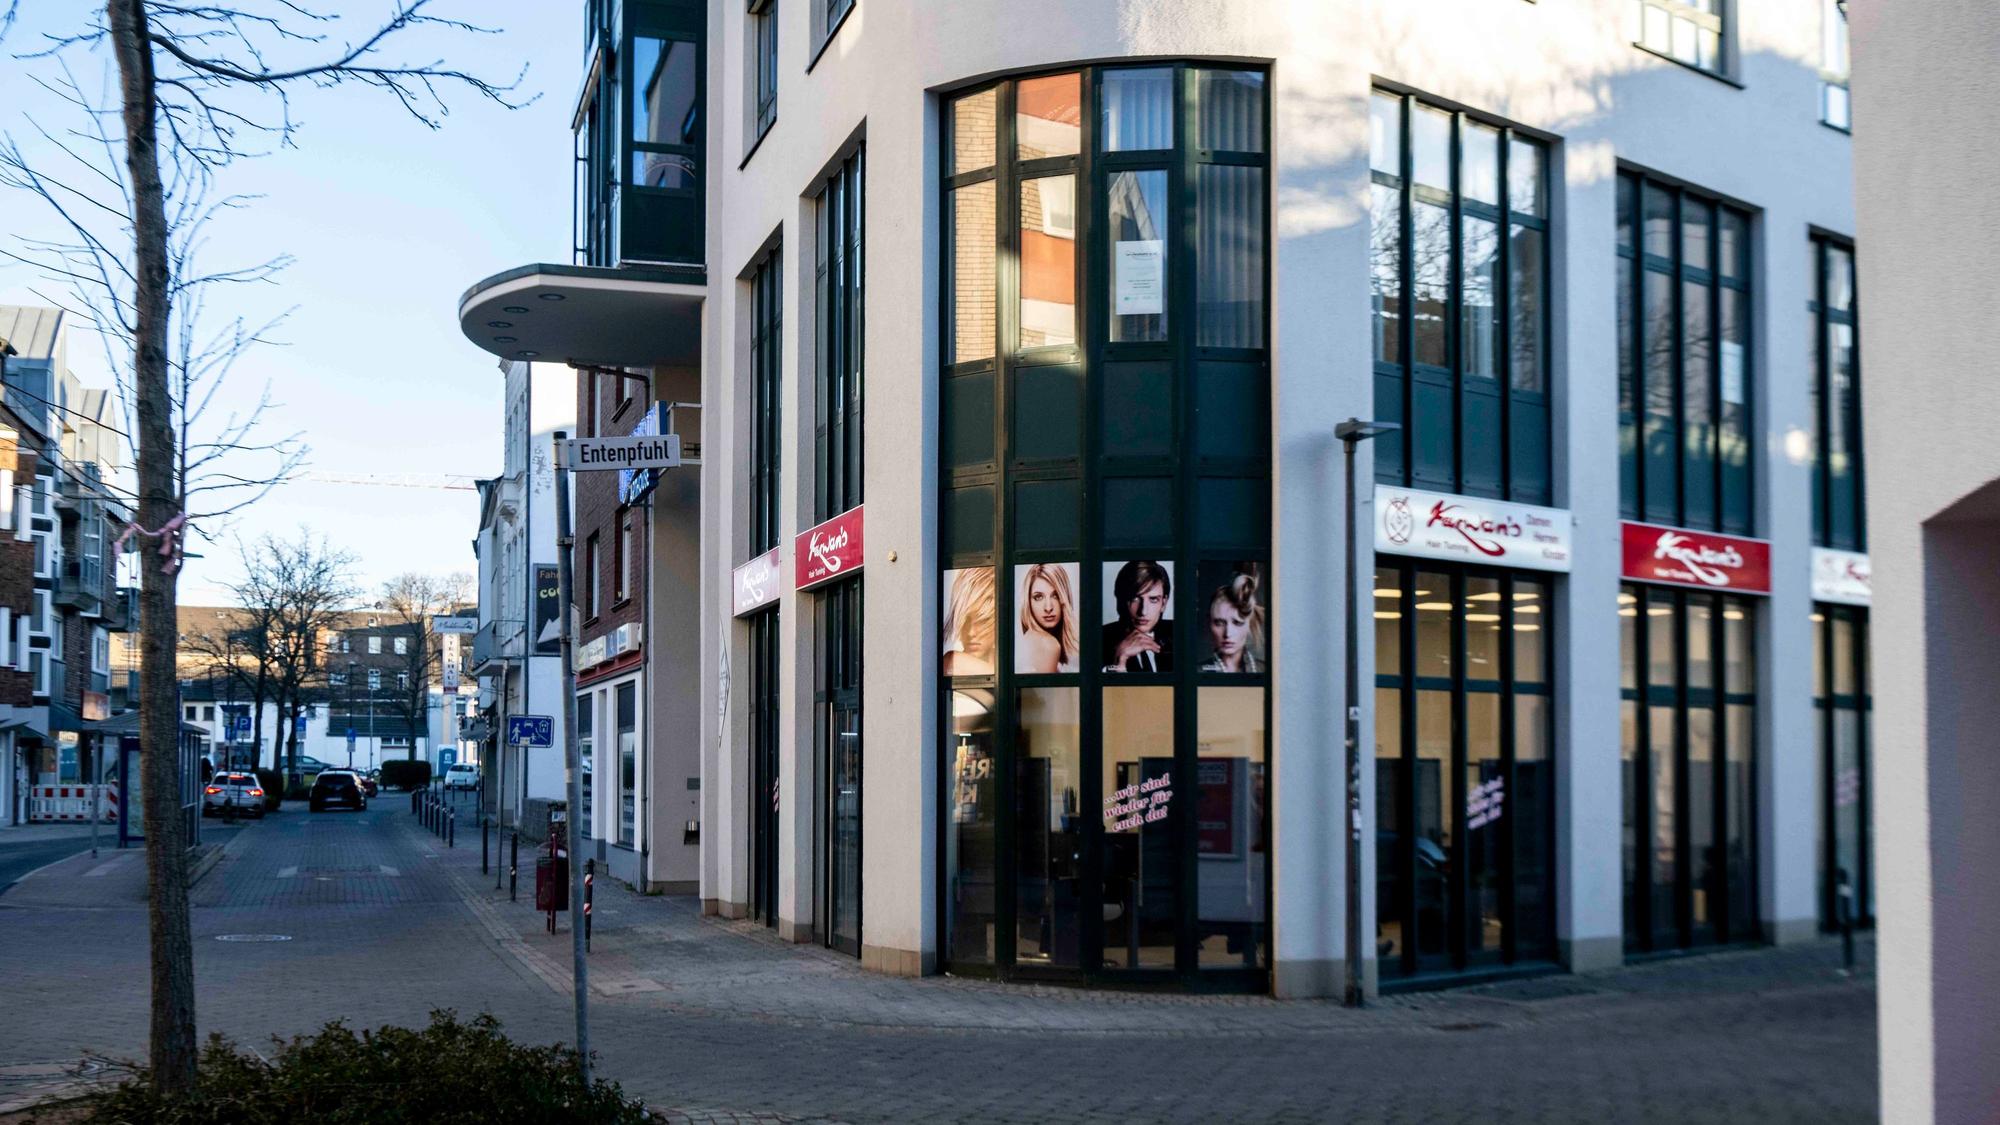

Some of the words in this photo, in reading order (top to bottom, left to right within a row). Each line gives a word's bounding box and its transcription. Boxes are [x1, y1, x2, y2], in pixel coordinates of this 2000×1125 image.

[581, 440, 669, 466] Entenpfuhl
[240, 718, 249, 729] P
[1140, 772, 1171, 793] sind
[1104, 797, 1149, 820] wieder
[1149, 789, 1173, 808] für
[1111, 813, 1144, 832] euch
